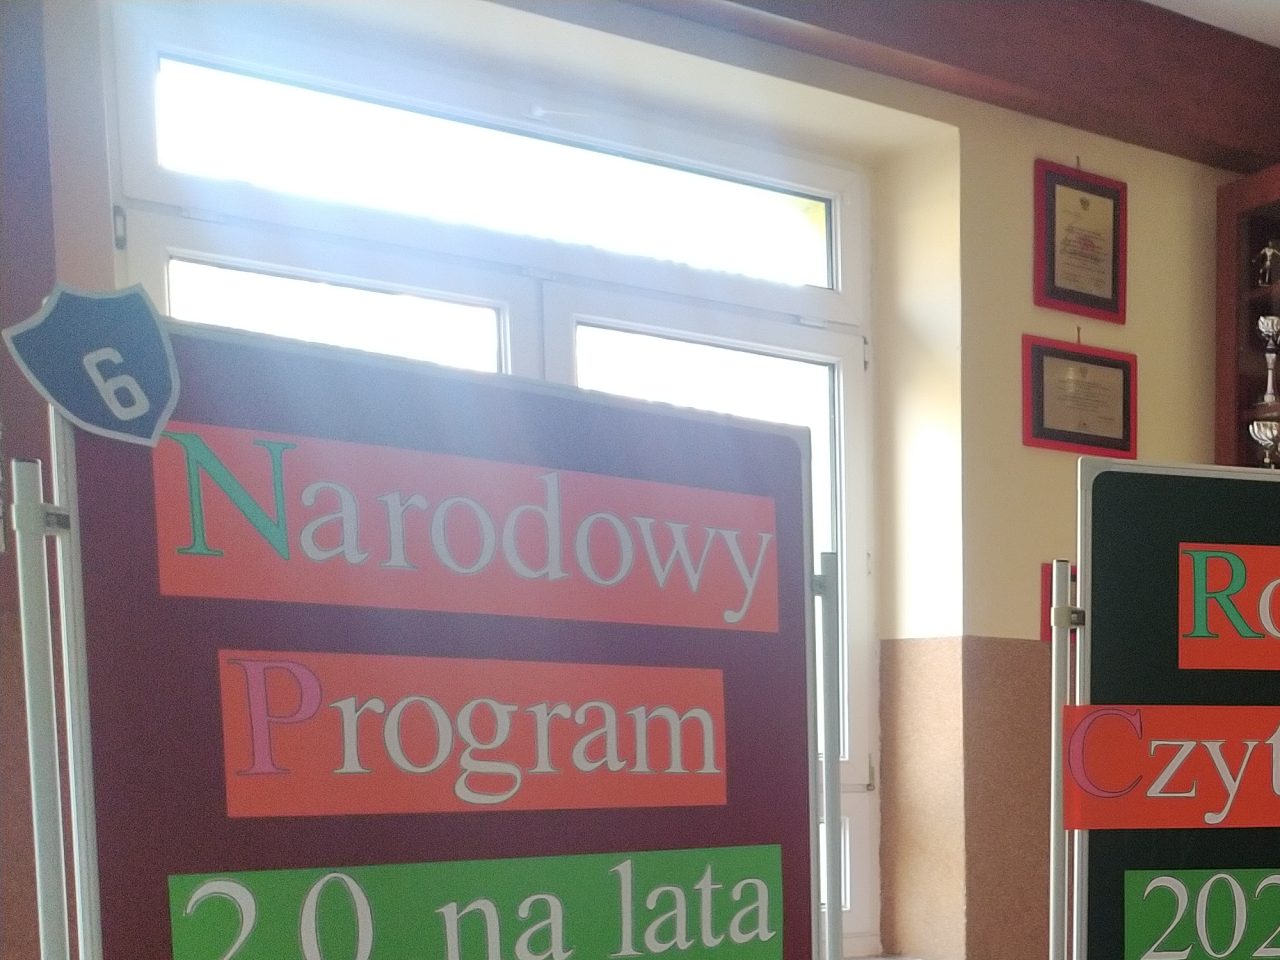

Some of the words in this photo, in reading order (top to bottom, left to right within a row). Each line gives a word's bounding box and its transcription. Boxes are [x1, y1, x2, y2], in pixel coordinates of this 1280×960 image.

[83, 347, 150, 421] 6
[163, 431, 774, 623] Narodowy
[227, 657, 724, 806] Program
[606, 858, 777, 960] lata
